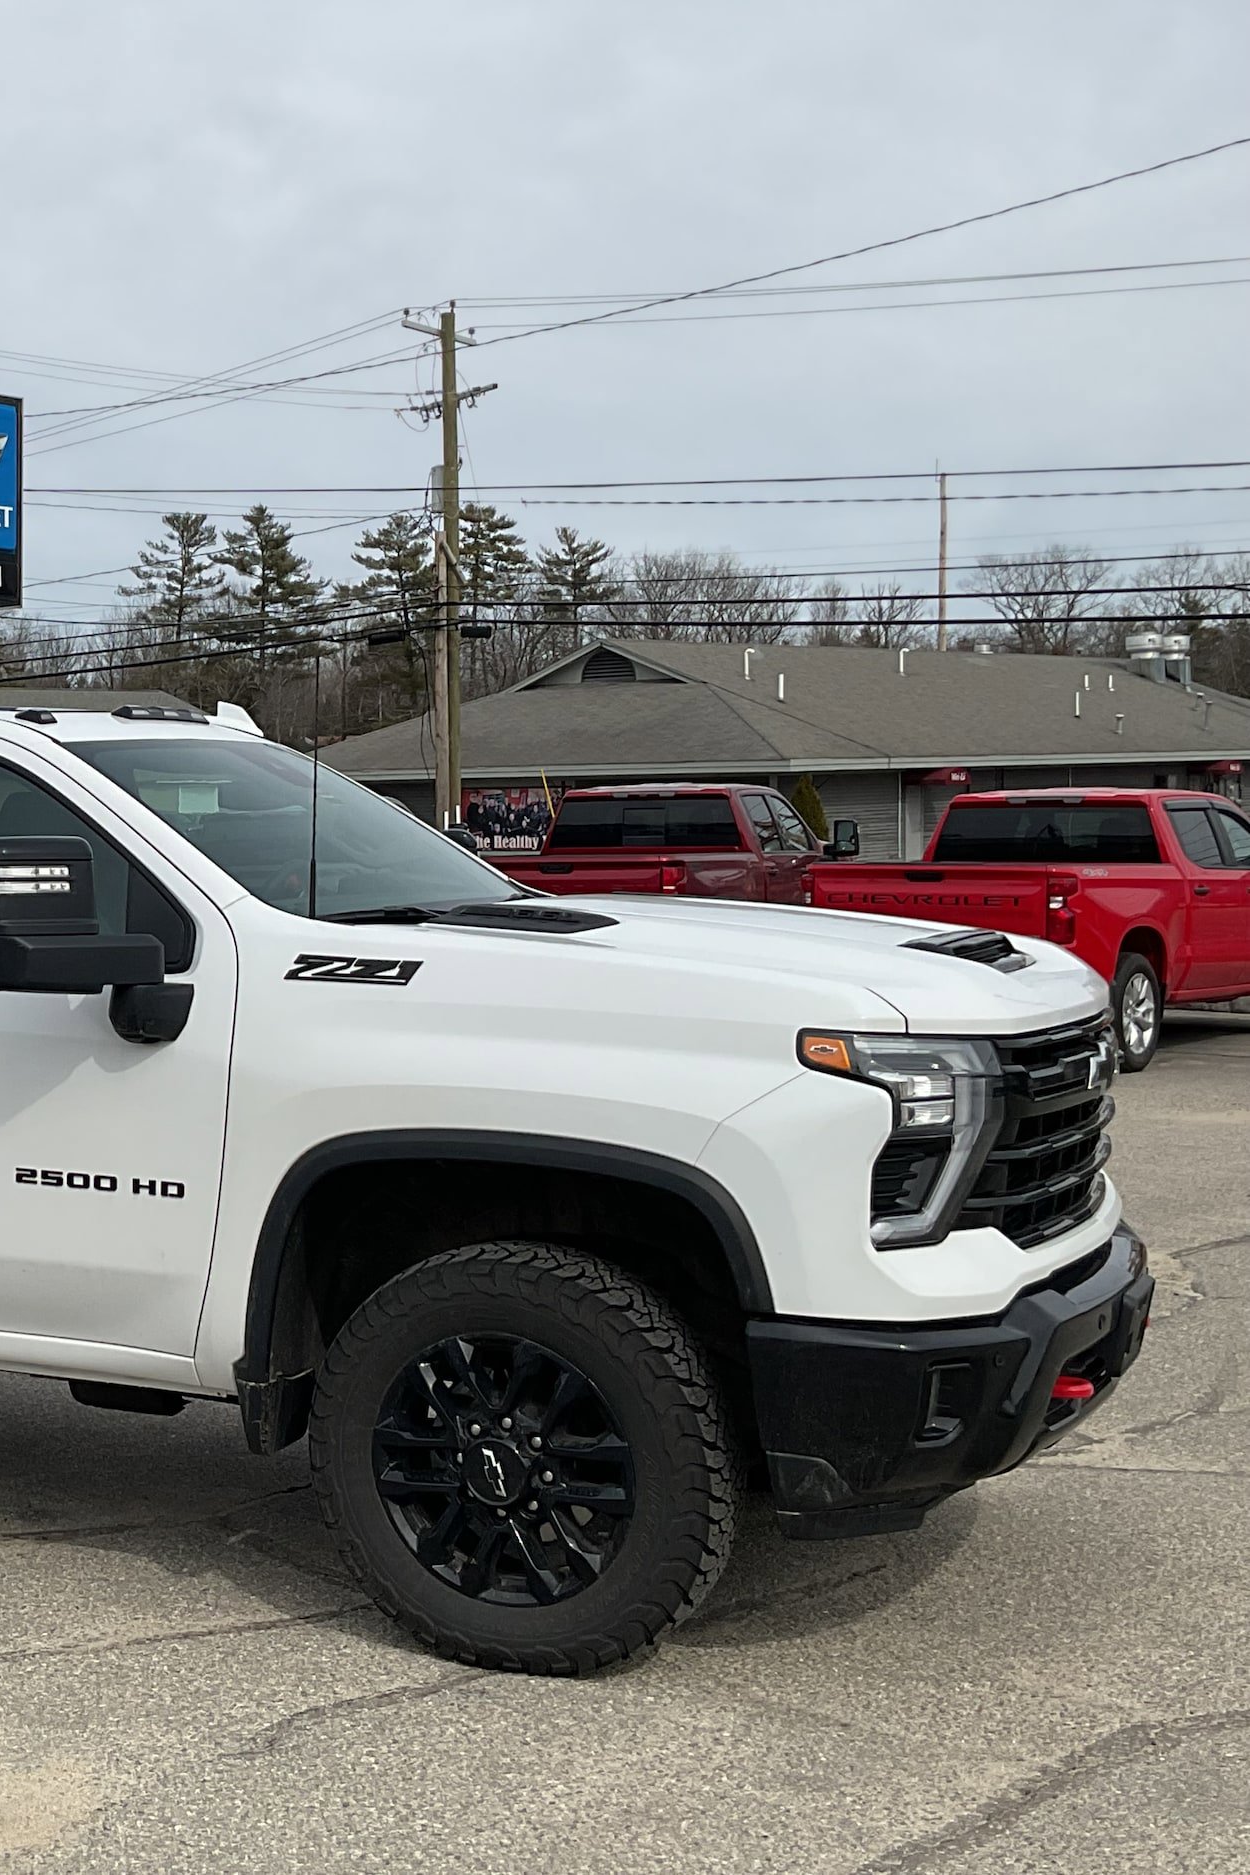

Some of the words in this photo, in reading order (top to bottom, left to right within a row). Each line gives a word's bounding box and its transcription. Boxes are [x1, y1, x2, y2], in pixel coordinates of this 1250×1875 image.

[476, 835, 491, 849] he
[493, 835, 540, 850] Healthy
[825, 893, 1024, 907] CHEVROLET
[283, 953, 424, 985] Z71
[15, 1167, 118, 1192] 2500
[132, 1178, 185, 1199] HD
